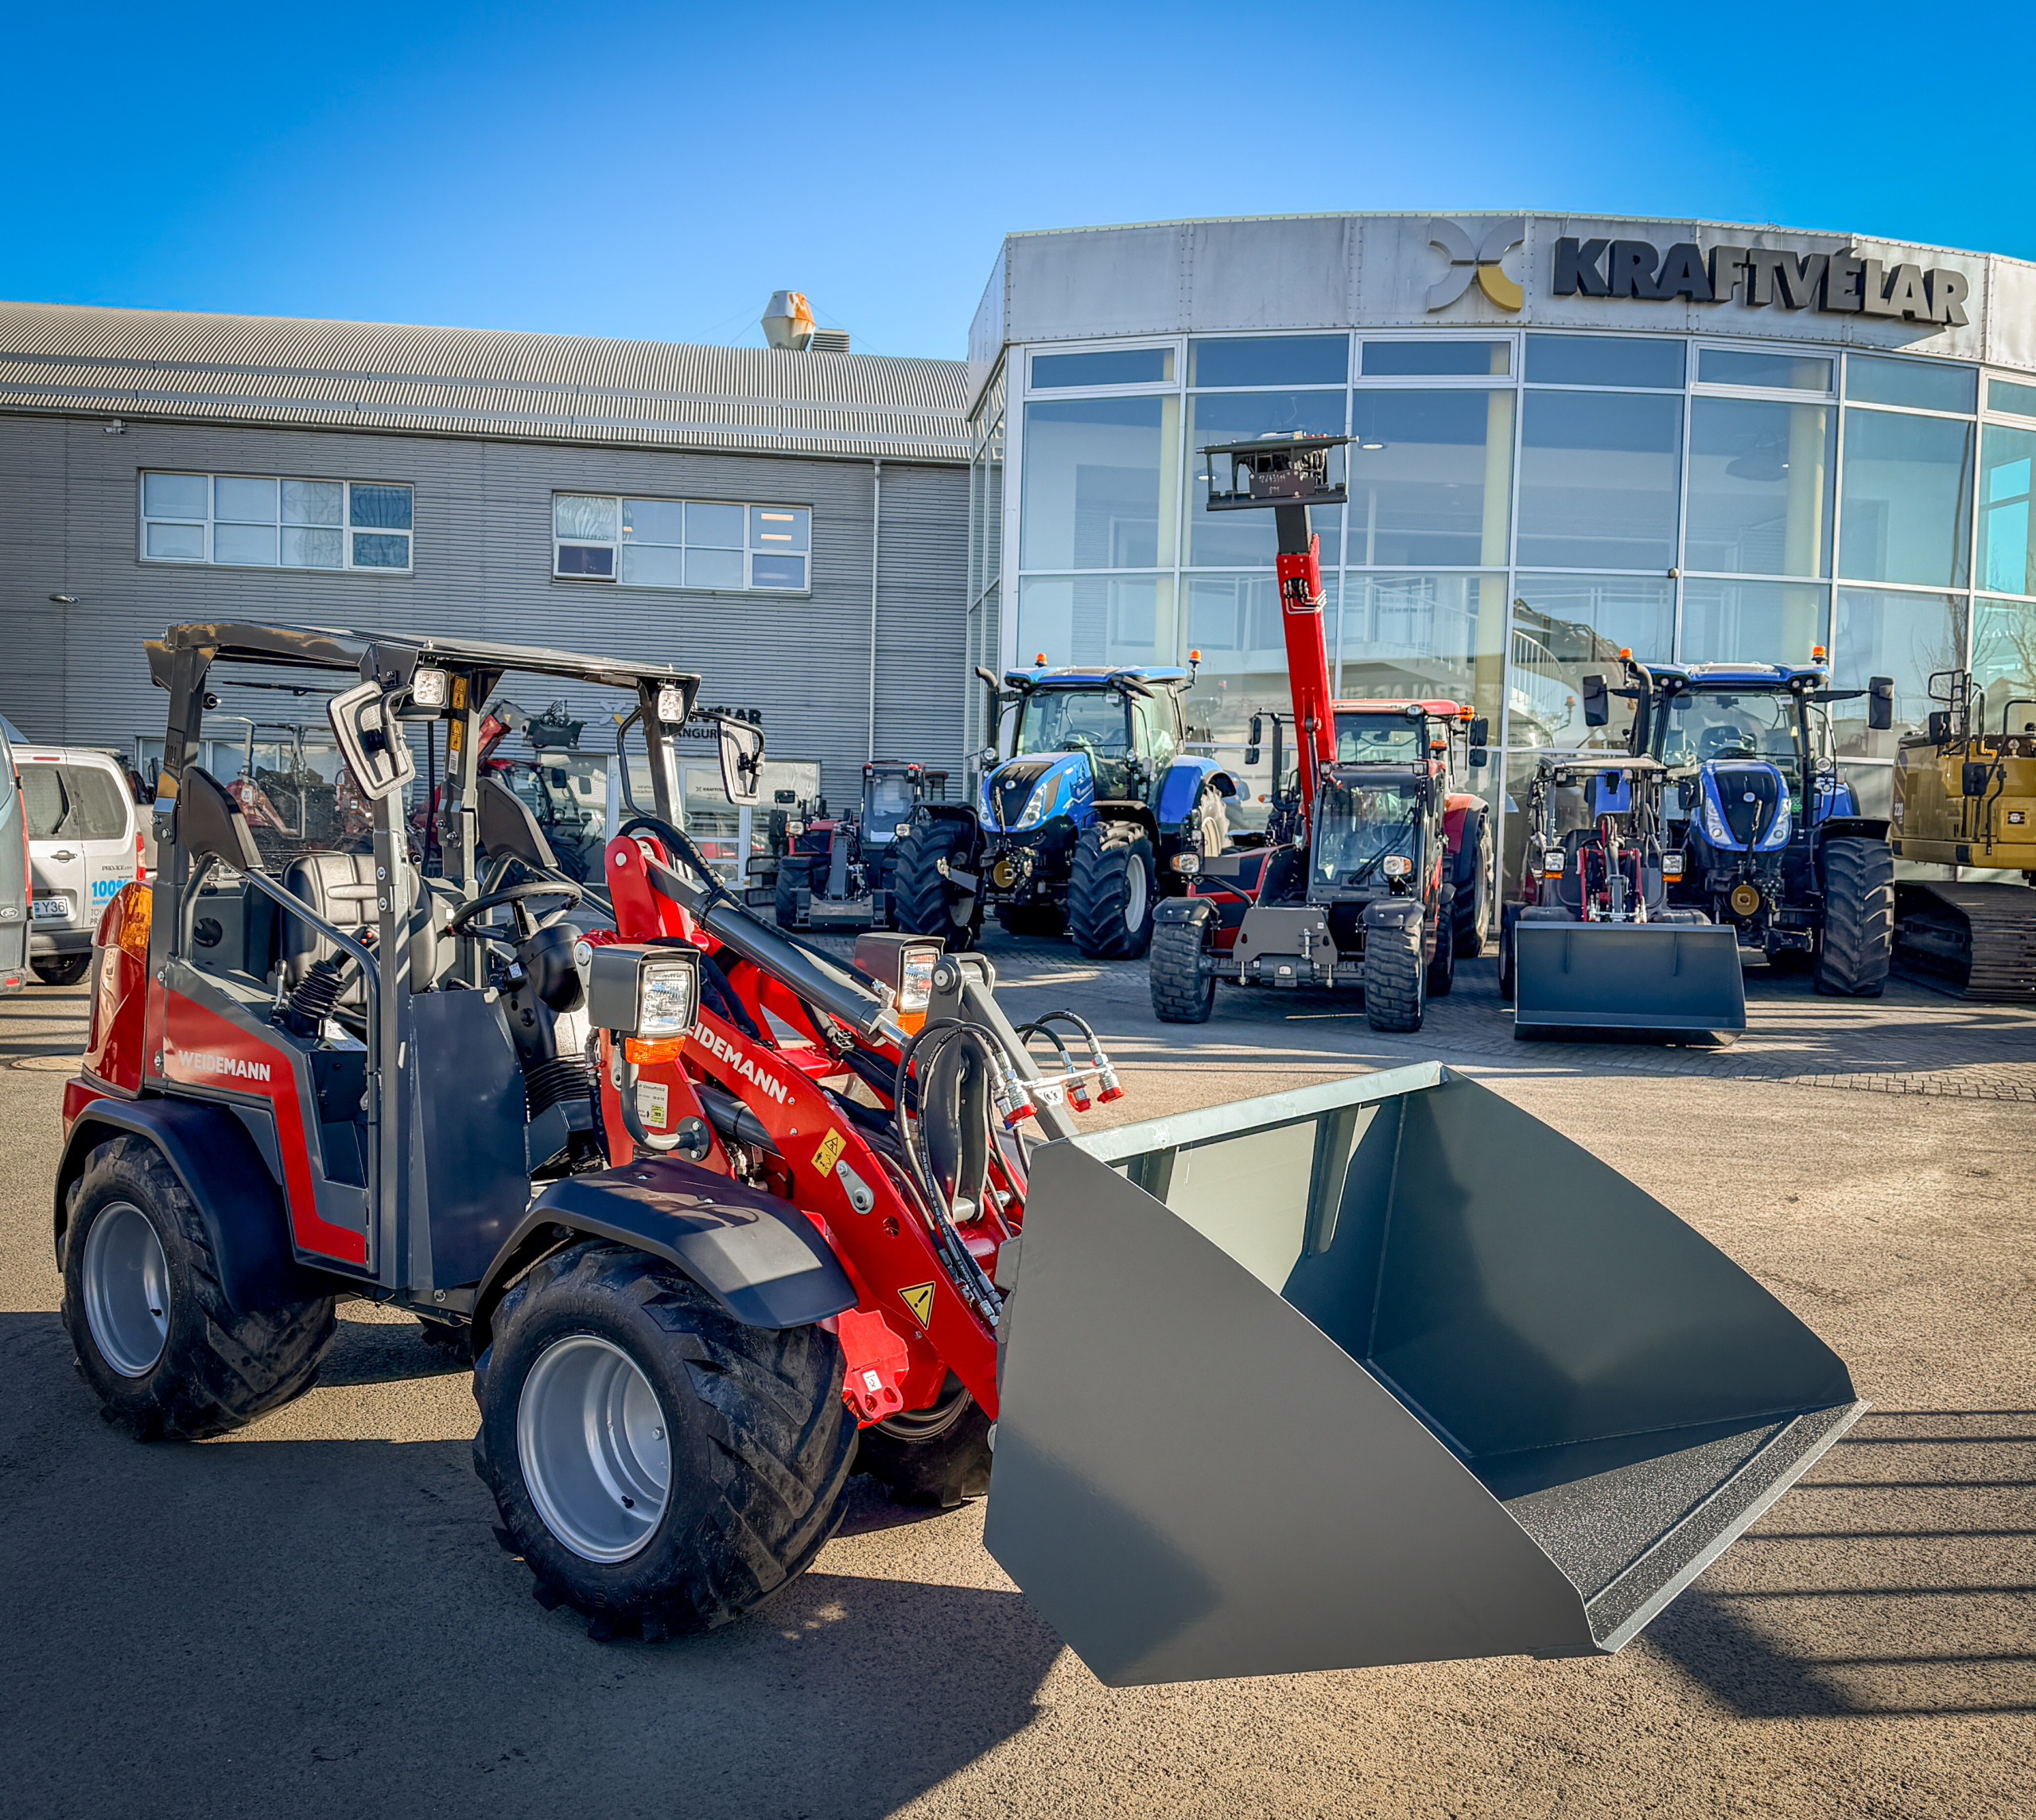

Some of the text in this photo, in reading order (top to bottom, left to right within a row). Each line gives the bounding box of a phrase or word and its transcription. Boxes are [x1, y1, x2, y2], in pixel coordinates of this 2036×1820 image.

[1552, 236, 1969, 327] KRAFTVÉLAR
[42, 901, 65, 913] Y36
[178, 1050, 270, 1082] WEIDEMANN
[687, 1022, 788, 1104] IDEMANN
